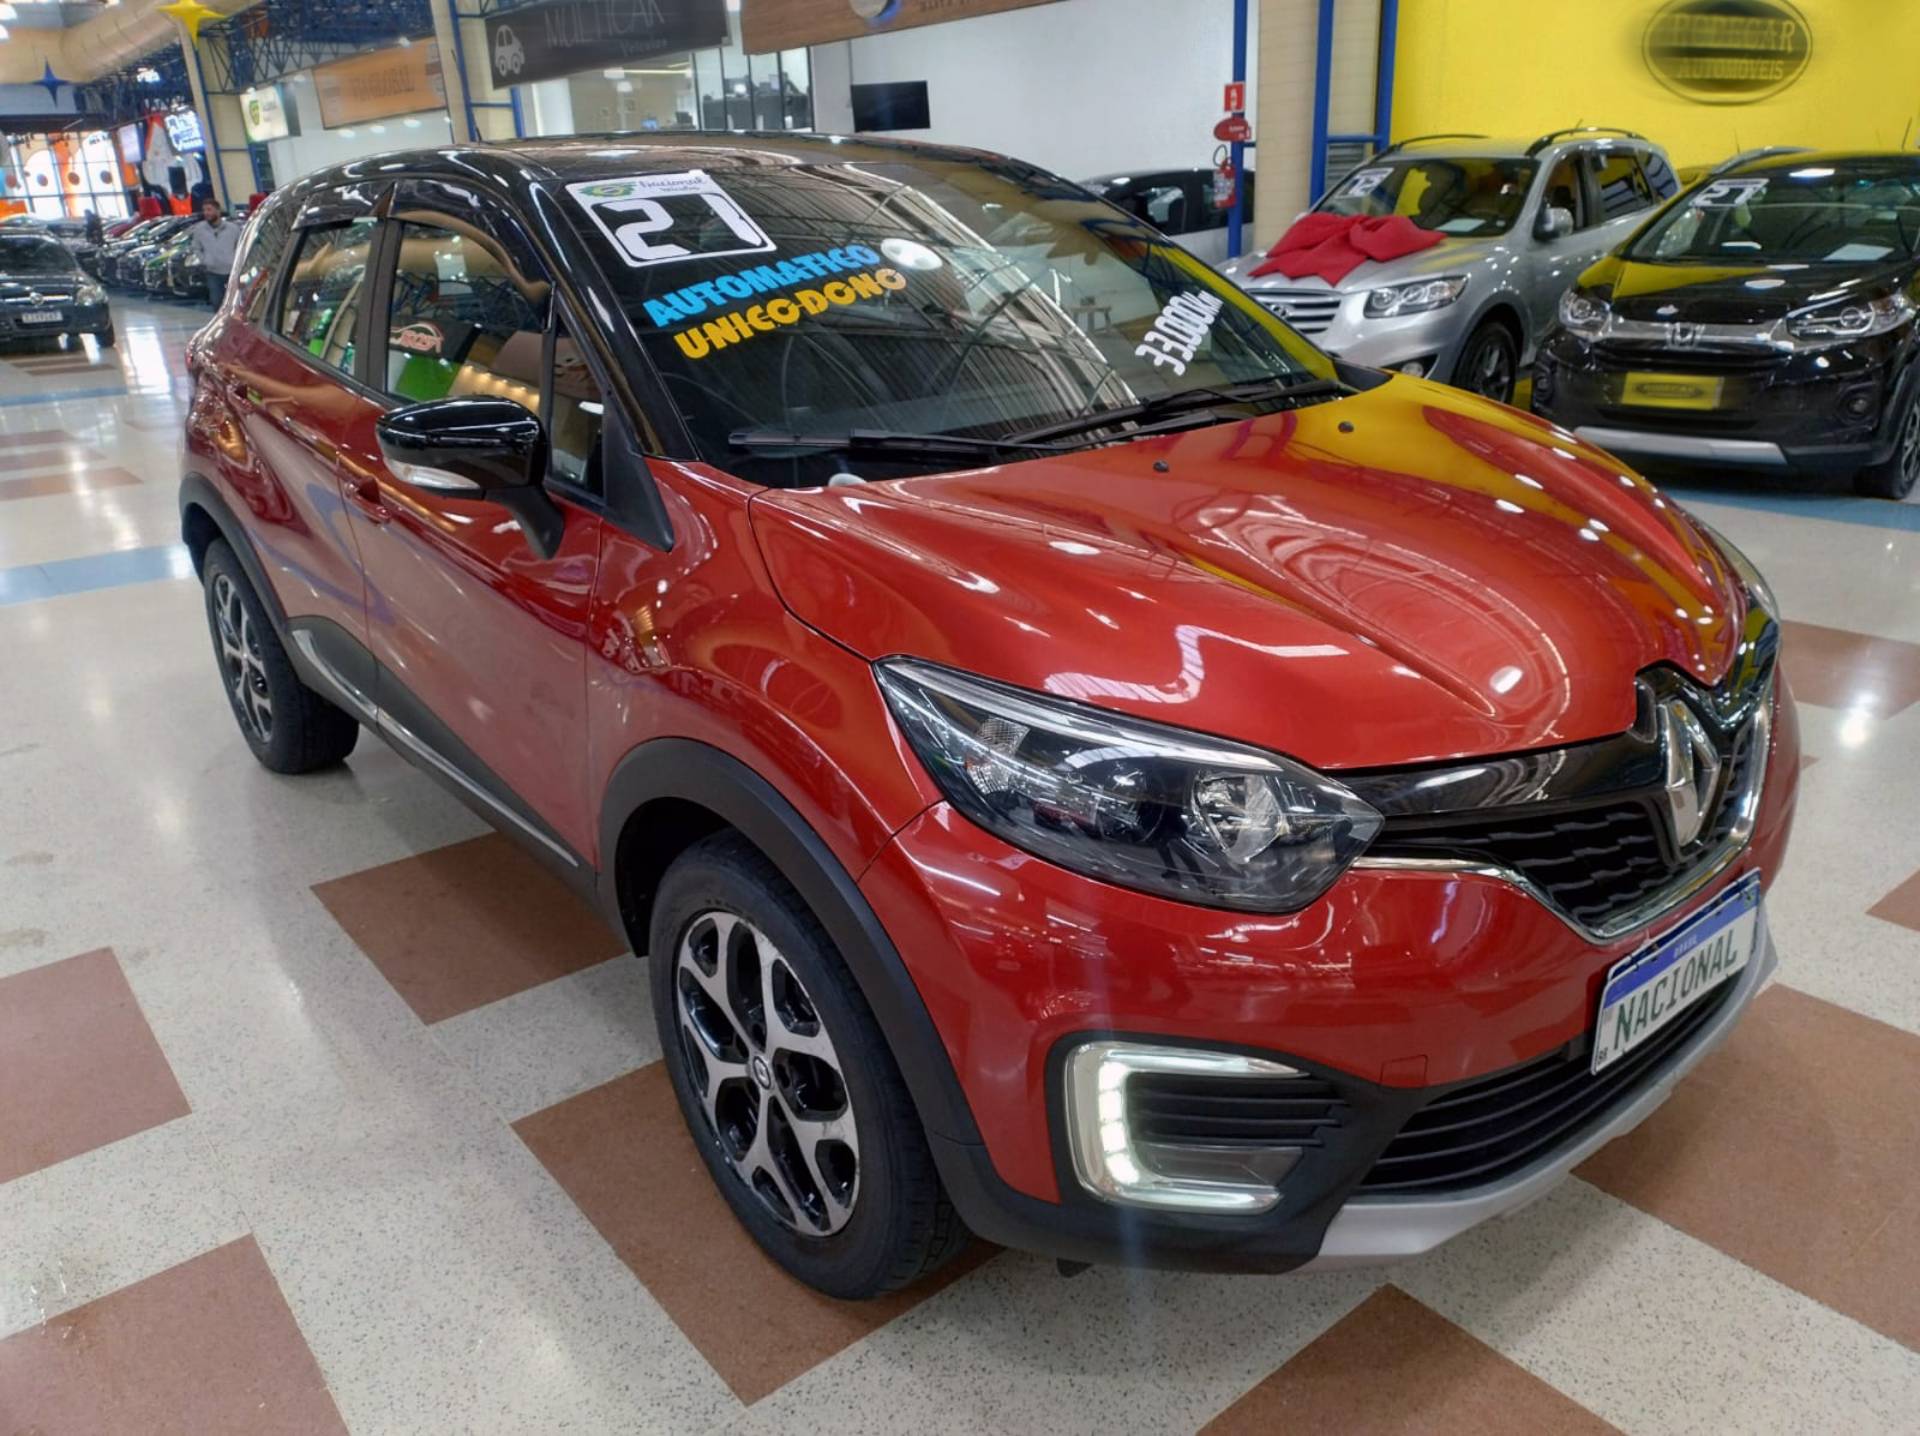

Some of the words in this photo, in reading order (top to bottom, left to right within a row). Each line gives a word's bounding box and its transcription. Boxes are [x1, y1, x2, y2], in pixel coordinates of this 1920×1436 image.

[601, 194, 763, 260] 21
[642, 244, 881, 328] AUTOMATICO
[1613, 929, 1738, 1051] NACIONAL
